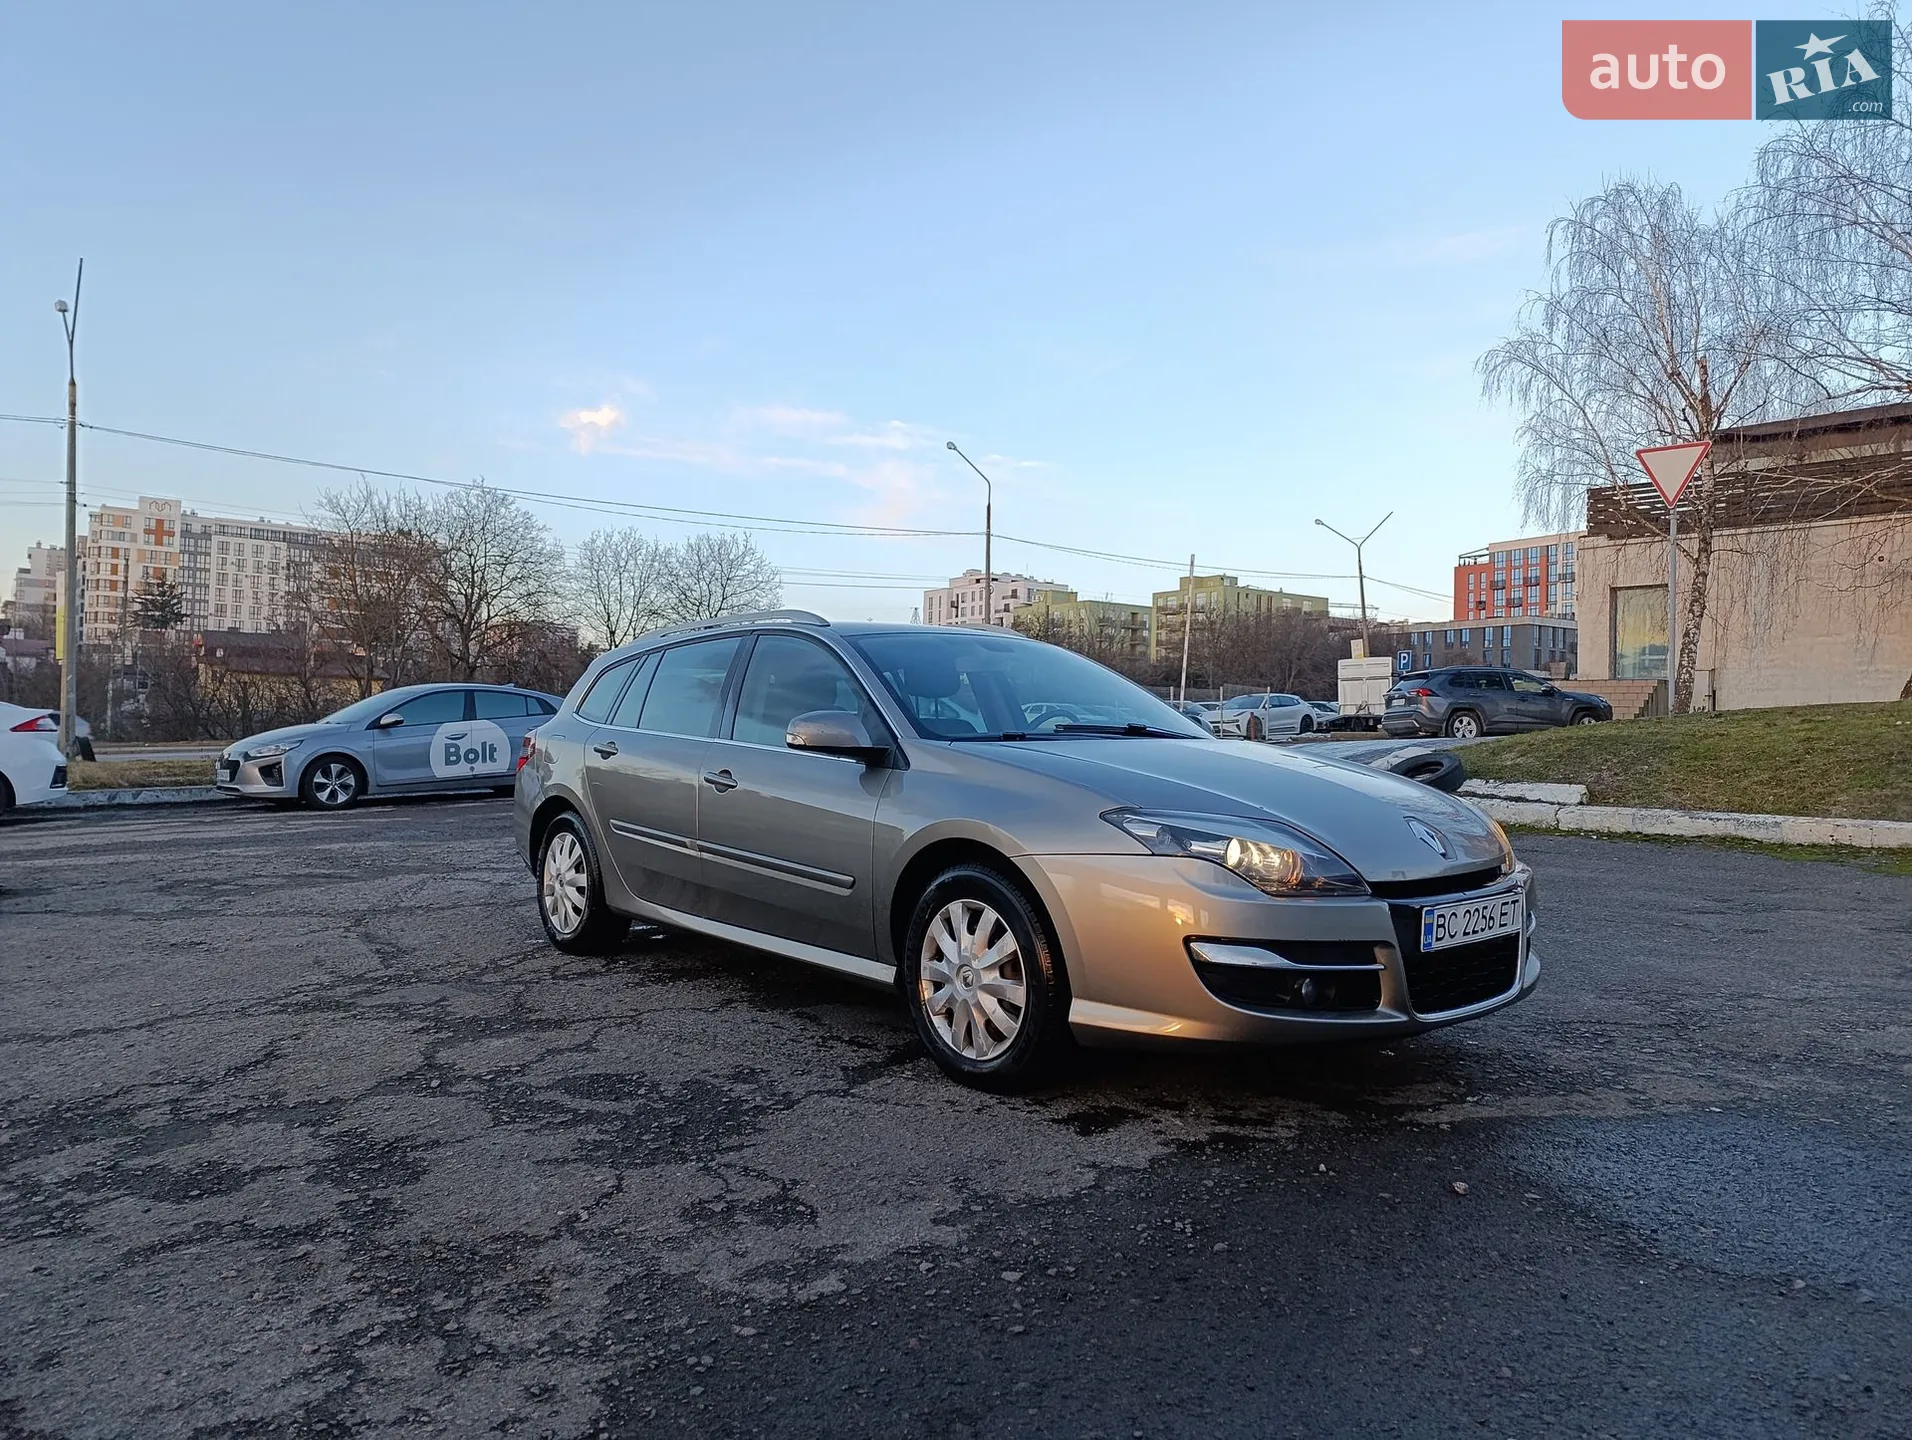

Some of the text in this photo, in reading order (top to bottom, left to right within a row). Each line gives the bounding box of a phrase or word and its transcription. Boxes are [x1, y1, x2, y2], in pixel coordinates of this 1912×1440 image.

[1400, 653, 1409, 669] P
[444, 741, 498, 766] Bolt
[1435, 900, 1520, 942] BC 2256 ET
